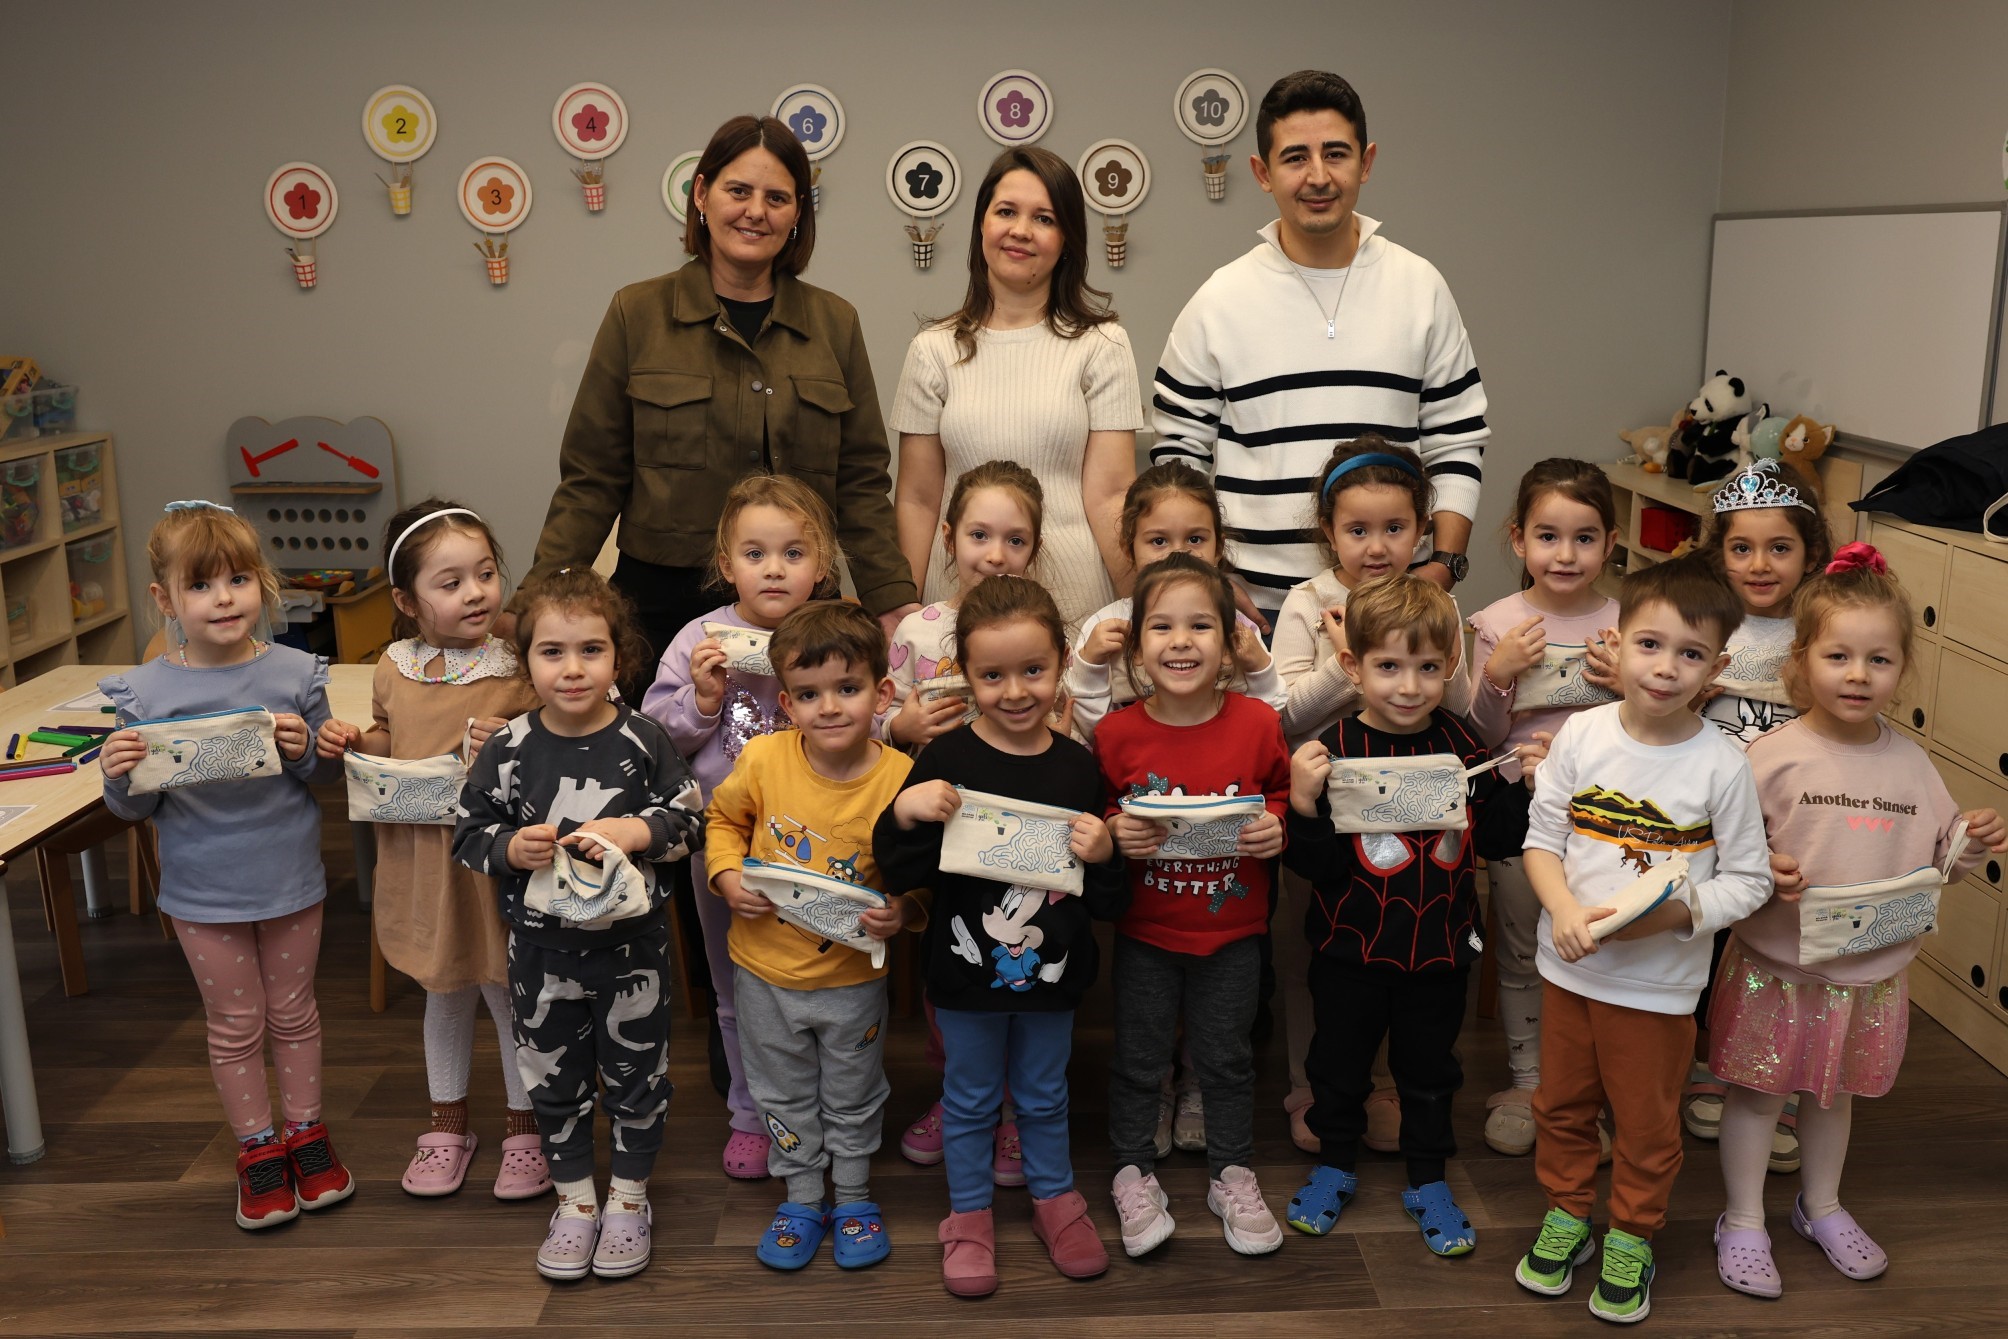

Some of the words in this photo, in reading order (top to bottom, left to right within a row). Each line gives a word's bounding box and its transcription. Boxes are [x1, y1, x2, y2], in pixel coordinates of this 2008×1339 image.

[1010, 102, 1021, 119] 8
[1200, 101, 1221, 118] 10
[396, 117, 407, 134] 2
[585, 116, 596, 133] 4
[802, 117, 814, 134] 6
[918, 174, 930, 191] 7
[1107, 172, 1119, 189] 9
[298, 194, 306, 210] 1
[490, 189, 502, 206] 3
[1798, 791, 1869, 809] Another
[1872, 796, 1918, 816] Sunset
[1144, 871, 1235, 895] BETTER
